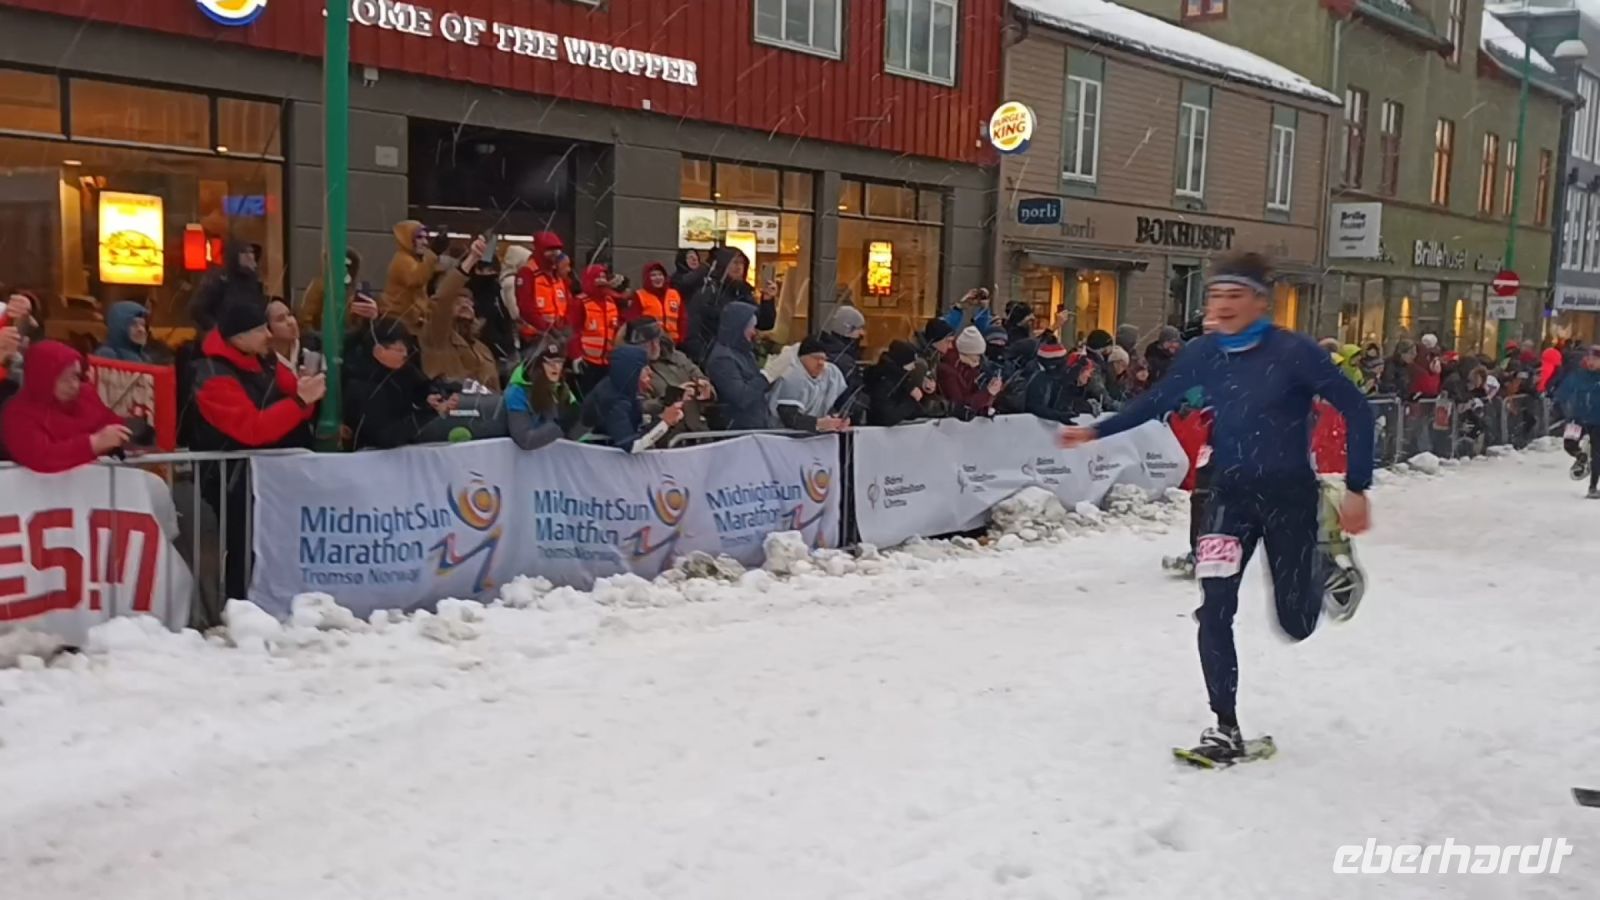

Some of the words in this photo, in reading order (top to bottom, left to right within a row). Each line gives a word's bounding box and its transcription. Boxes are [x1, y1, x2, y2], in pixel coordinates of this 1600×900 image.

[323, 0, 432, 36] OME
[440, 12, 487, 45] OF
[492, 22, 559, 61] THE
[563, 36, 699, 86] WHOPPER
[993, 111, 1026, 129] BURGER
[993, 121, 1026, 140] KING
[1021, 203, 1056, 222] norli
[1136, 216, 1236, 250] BOKHUSET
[301, 502, 452, 541] MidnightSun
[300, 536, 423, 565] Marathon
